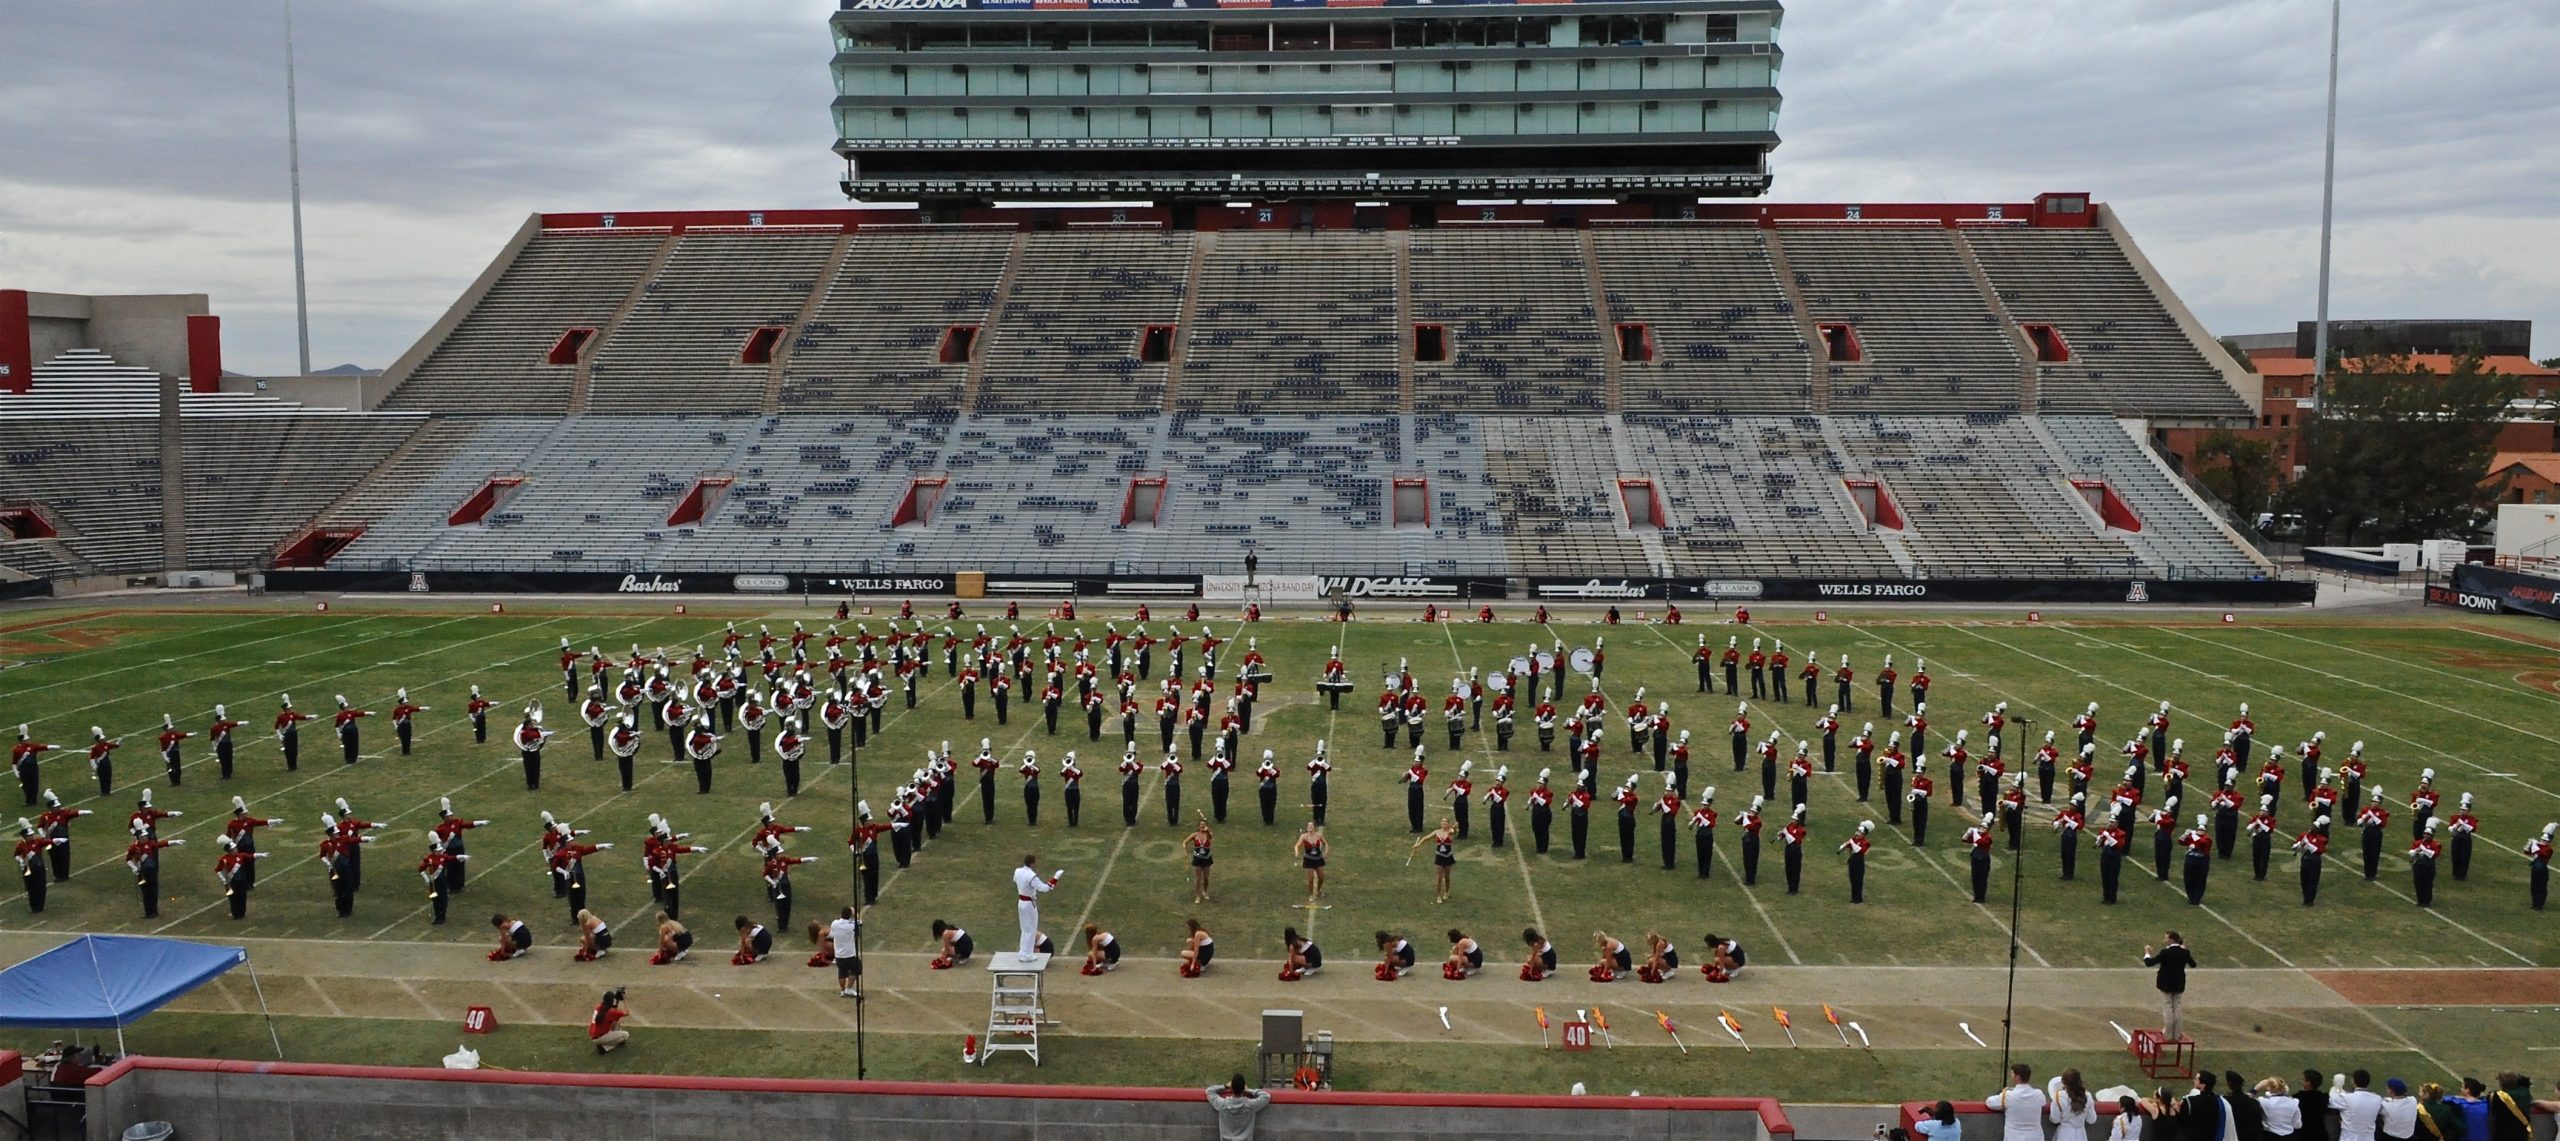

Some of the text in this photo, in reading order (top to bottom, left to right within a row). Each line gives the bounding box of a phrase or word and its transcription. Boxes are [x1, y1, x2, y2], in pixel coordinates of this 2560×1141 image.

[853, 0, 967, 9] ARIZONA
[1112, 213, 1126, 223] 20
[1259, 212, 1272, 222] 21
[1482, 211, 1496, 221] 22
[1682, 210, 1696, 220] 23
[1847, 211, 1860, 220] 24
[1988, 211, 2002, 220] 25
[604, 219, 614, 228] 17
[751, 217, 762, 226] 18
[257, 380, 268, 390] 16
[618, 574, 682, 592] Bashas'
[841, 579, 944, 590] WELLS FARGO
[1282, 582, 1300, 592] BAND
[1302, 582, 1315, 592] DAY
[1818, 584, 1926, 596] WELLS FARGO
[2459, 593, 2497, 611] DOWN
[466, 1010, 485, 1030] 40
[1567, 1026, 1585, 1046] 40
